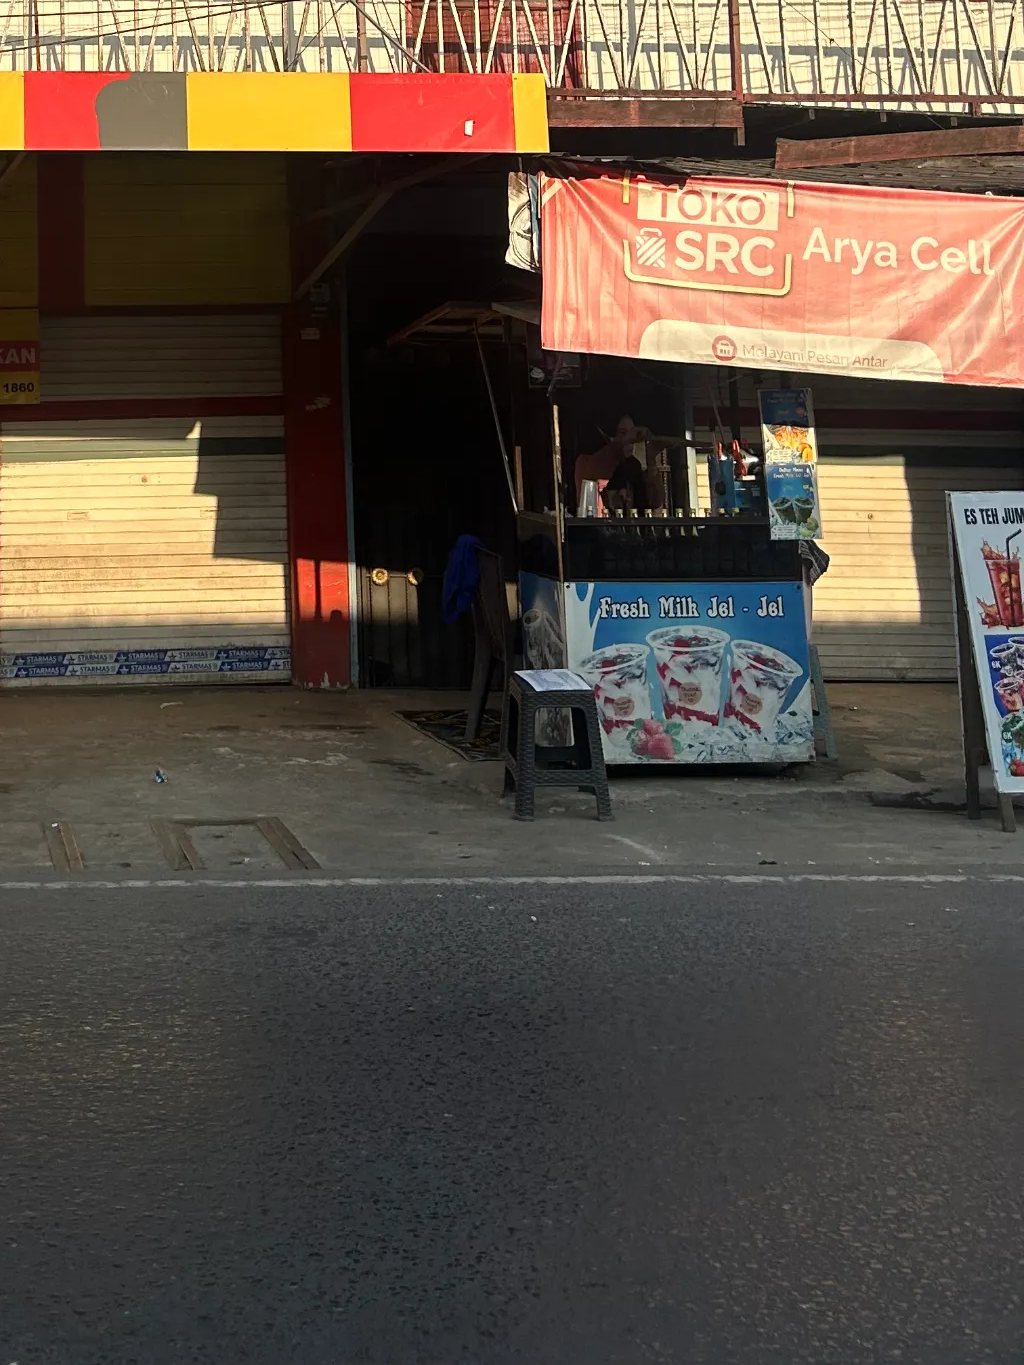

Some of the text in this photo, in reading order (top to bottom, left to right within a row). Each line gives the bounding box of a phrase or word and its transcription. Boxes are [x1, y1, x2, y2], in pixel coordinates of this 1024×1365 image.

[651, 188, 766, 226] TOKO
[675, 230, 776, 277] SRC
[802, 227, 995, 276] Arya Cell
[742, 344, 888, 368] Melayani Pesan Antar
[3, 382, 35, 394] 1860
[963, 508, 978, 525] ES
[979, 507, 1000, 525] TEH
[598, 595, 651, 619] Fresh
[658, 595, 701, 619] Milk
[707, 596, 735, 619] Jel
[756, 595, 785, 618] Jel
[26, 655, 57, 664] STARMAS
[77, 654, 108, 662] STARMAS
[128, 652, 159, 660] STARMAS
[228, 649, 259, 658] STARMAS
[991, 660, 1001, 669] 6K
[28, 666, 60, 675] STARMAS
[79, 664, 110, 673] STARMAS
[130, 663, 162, 672] STARMAS
[182, 662, 212, 670] STARMAS
[232, 661, 263, 670] STARMAS
[1002, 731, 1012, 740] 6K
